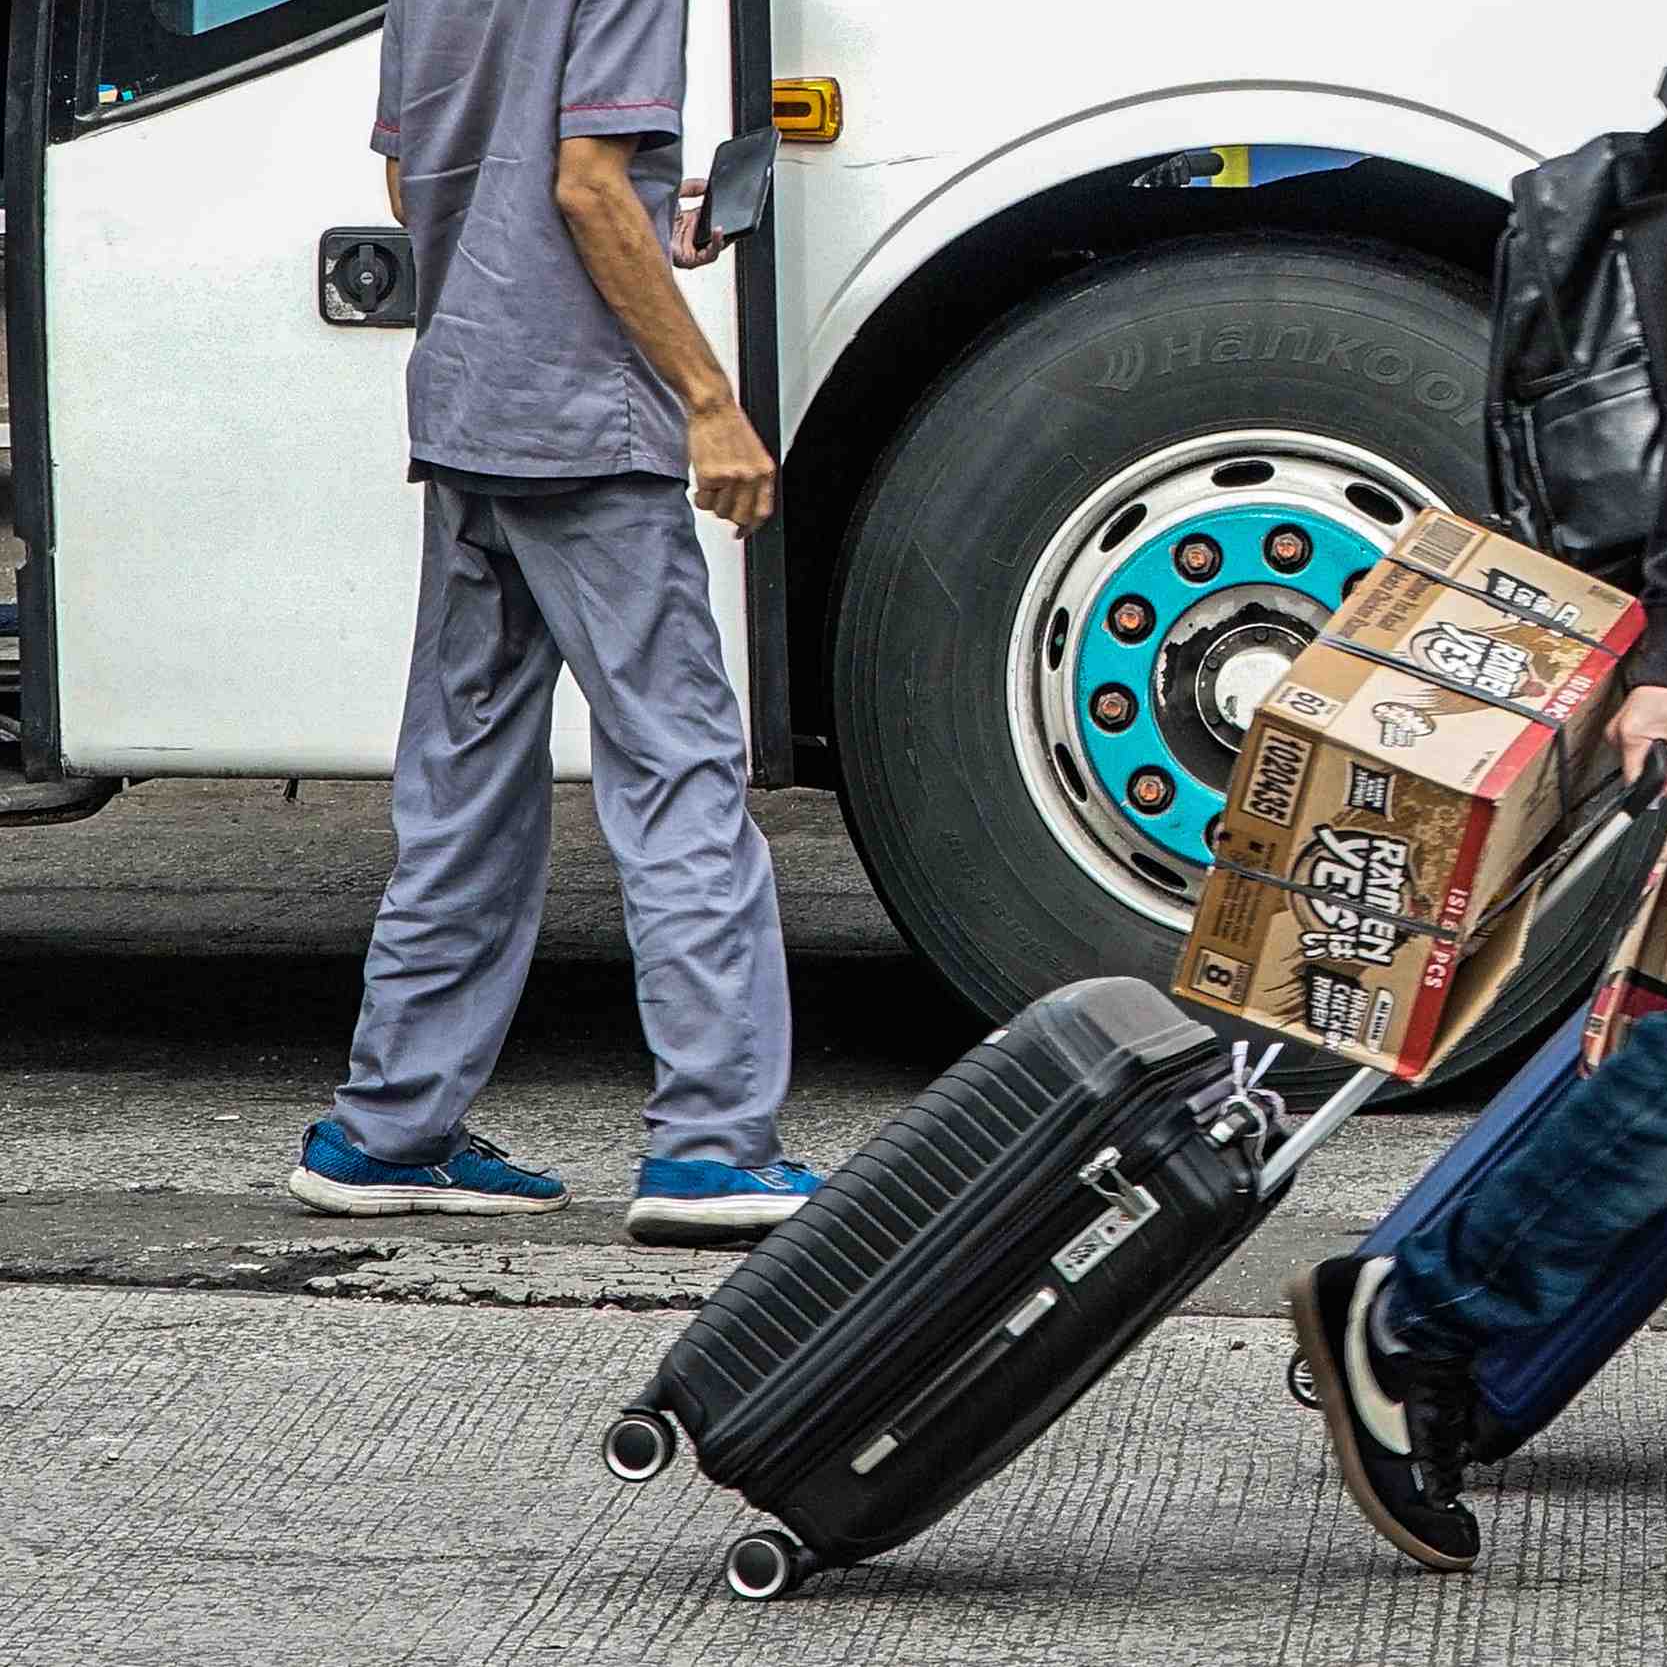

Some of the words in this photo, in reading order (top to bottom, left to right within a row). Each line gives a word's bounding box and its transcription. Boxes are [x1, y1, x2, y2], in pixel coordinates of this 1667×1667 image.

[1289, 691, 1326, 715] 60
[1248, 734, 1307, 820] 1020435
[1356, 838, 1408, 965] RAMEN
[1205, 963, 1233, 989] 8
[1423, 949, 1452, 990] PCS
